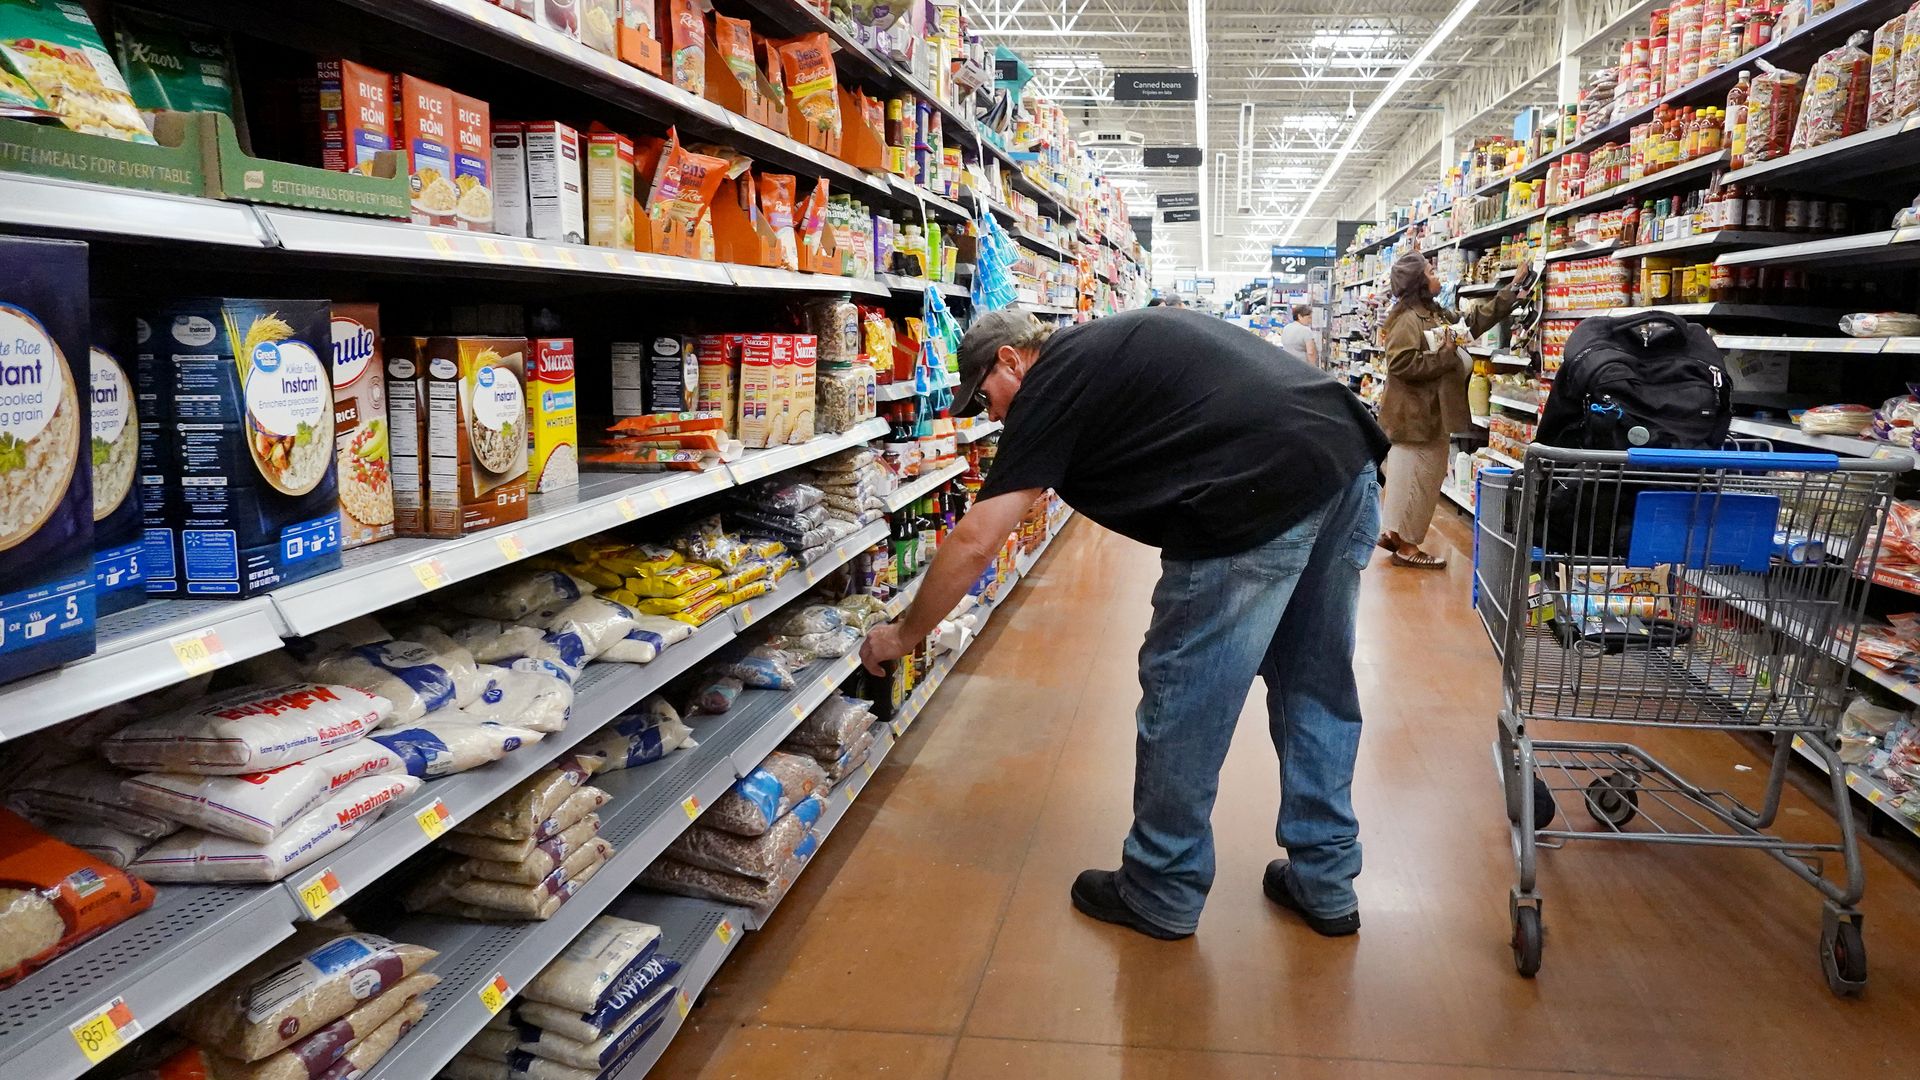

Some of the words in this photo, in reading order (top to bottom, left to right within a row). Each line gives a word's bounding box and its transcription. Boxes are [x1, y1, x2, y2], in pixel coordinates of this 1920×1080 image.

[131, 42, 184, 69] Knorr
[317, 62, 339, 70] RICE
[317, 70, 340, 79] RONI
[359, 82, 384, 102] RICE
[1133, 81, 1160, 89] Canned
[1161, 81, 1182, 89] beans
[419, 95, 442, 115] RICE
[361, 107, 385, 126] RONI
[459, 109, 481, 127] RICE
[420, 118, 444, 137] RONI
[460, 130, 482, 148] RONI
[39, 150, 88, 171] MEALS
[90, 157, 119, 174] FOR
[119, 160, 156, 180] EVERY
[157, 166, 193, 185] TABLE
[272, 180, 308, 197] BETTER
[307, 185, 337, 201] MEALS
[338, 189, 357, 203] FOR
[357, 192, 381, 206] EVERY
[380, 195, 404, 208] TABLE
[15, 338, 41, 355] Rice
[256, 350, 278, 361] Great
[796, 341, 817, 359] Success
[540, 348, 574, 373] Success
[100, 369, 117, 382] Rice
[281, 375, 318, 394] Instant
[495, 390, 517, 402] Instant
[12, 409, 43, 425] grain
[336, 407, 357, 424] RICE
[100, 420, 119, 431] grain
[328, 525, 335, 541] 5
[130, 556, 138, 574] 5
[1877, 574, 1905, 588] MEDIUM
[66, 595, 78, 620] 5
[9, 622, 21, 632] OR
[317, 719, 363, 741] Mahatma
[284, 849, 299, 864] Extra
[299, 841, 313, 855] Long
[311, 828, 332, 847] Enriched
[336, 789, 391, 826] Mahatma
[305, 885, 326, 910] 272
[608, 958, 665, 1010] RICELAND
[81, 1020, 108, 1052] 857
